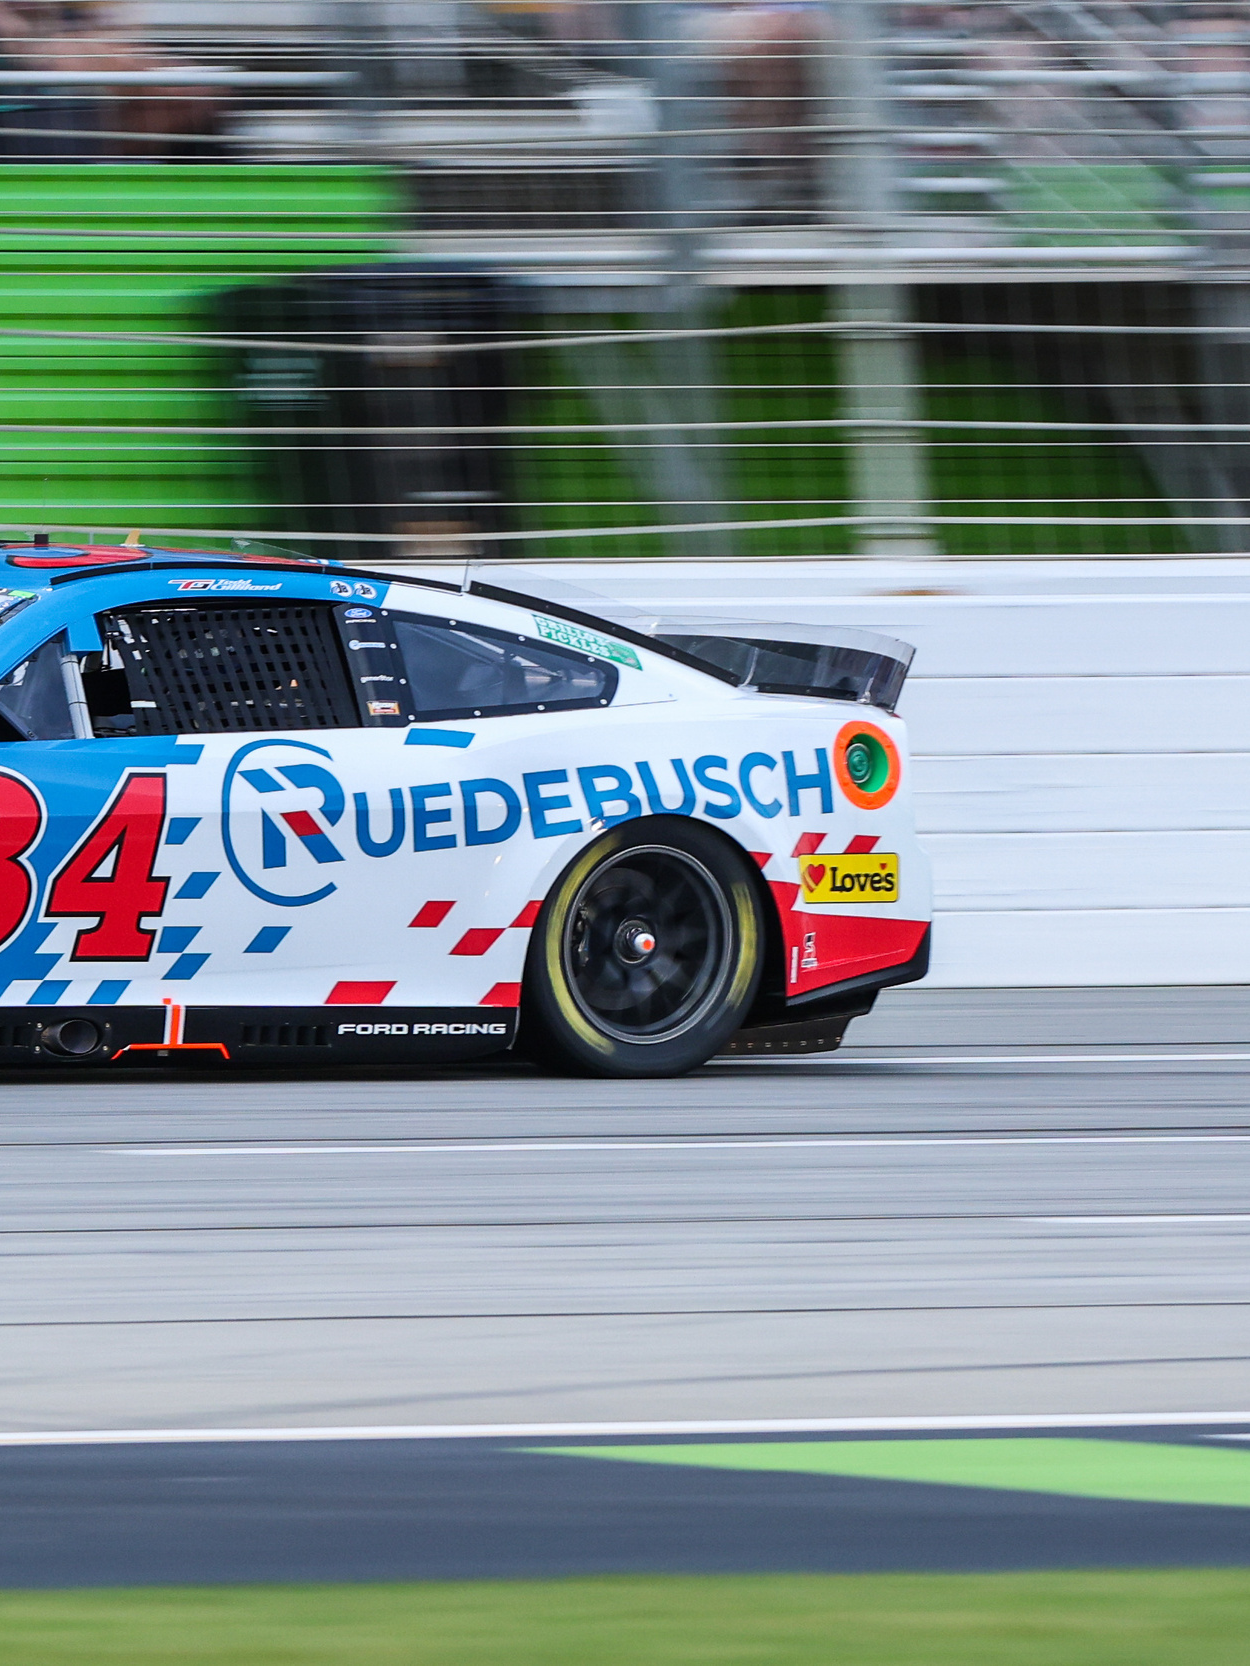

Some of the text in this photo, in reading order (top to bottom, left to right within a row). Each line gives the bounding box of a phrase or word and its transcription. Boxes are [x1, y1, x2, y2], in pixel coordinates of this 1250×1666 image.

[539, 625, 611, 657] PICKLES
[829, 862, 895, 892] Love's
[337, 1024, 507, 1034] FORD RACING
